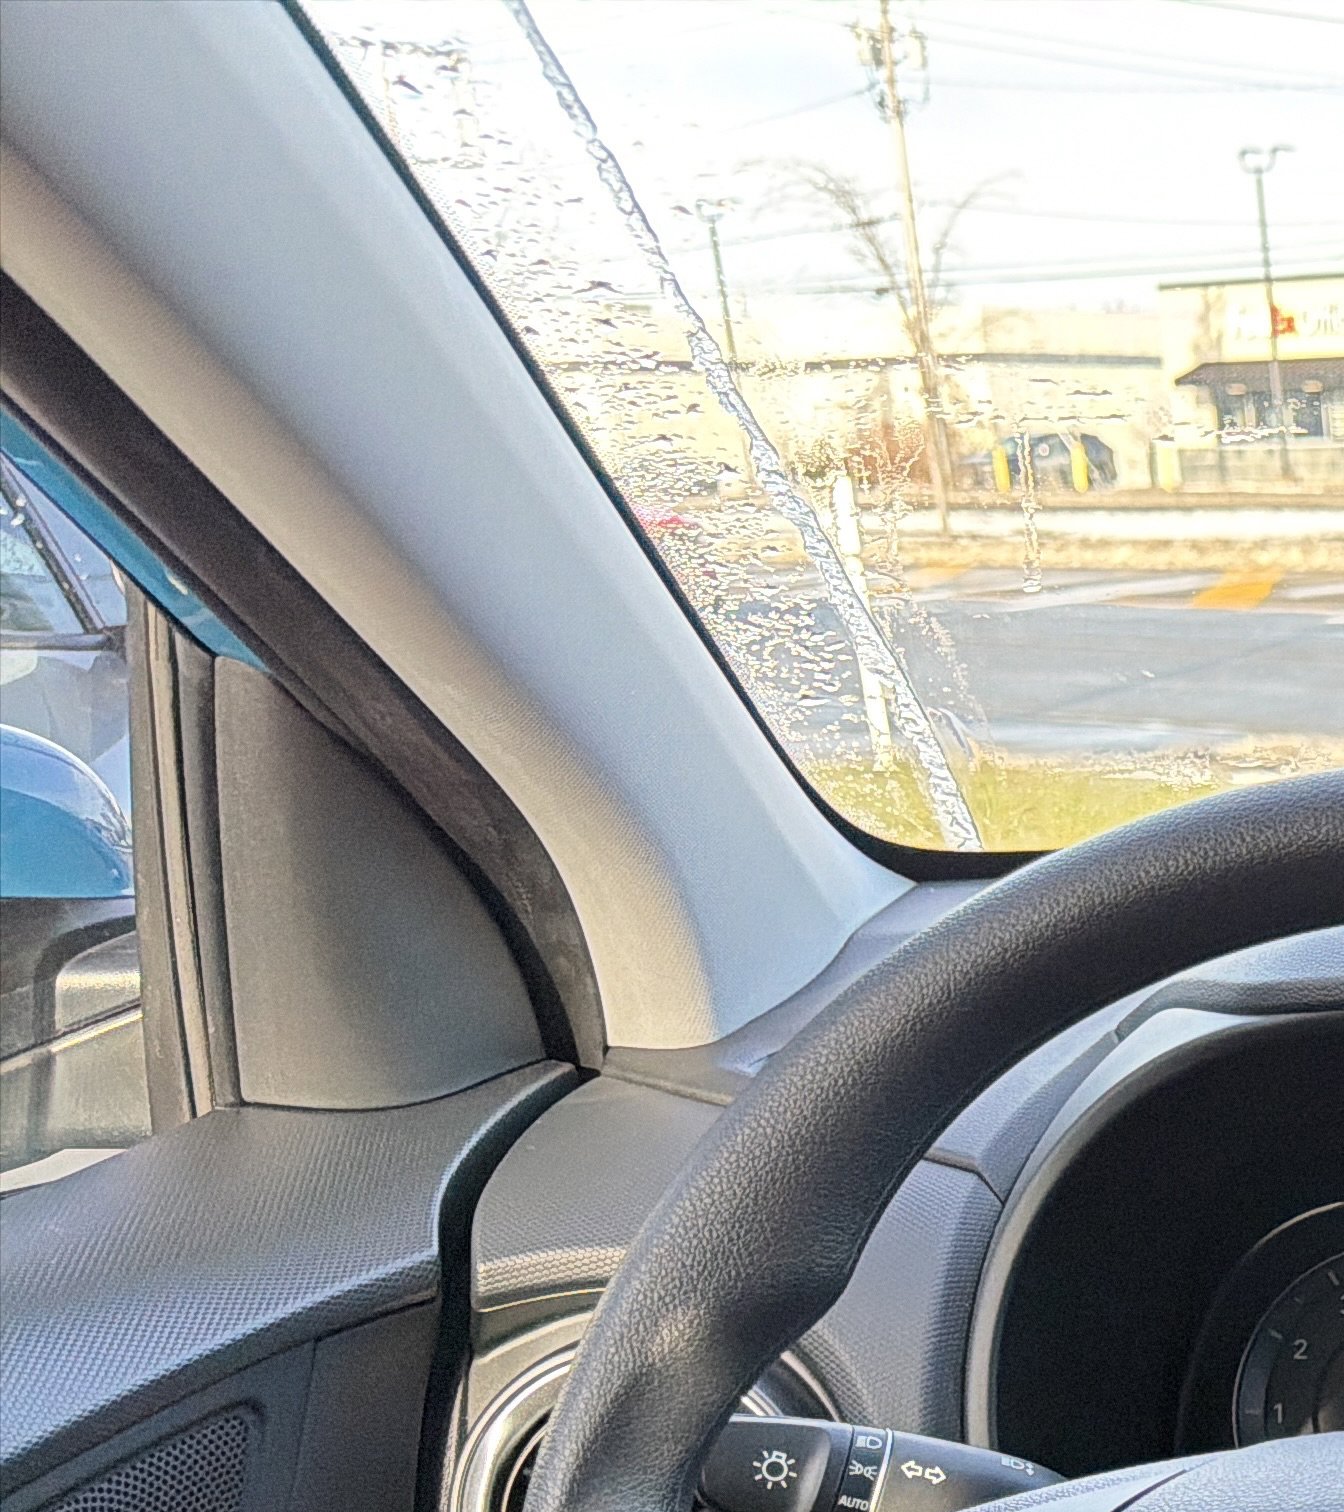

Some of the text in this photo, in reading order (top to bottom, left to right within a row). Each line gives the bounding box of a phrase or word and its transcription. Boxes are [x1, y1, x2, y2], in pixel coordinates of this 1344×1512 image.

[1293, 1338, 1309, 1361] 2
[1272, 1402, 1284, 1425] 1
[837, 1494, 869, 1511] AUTO
